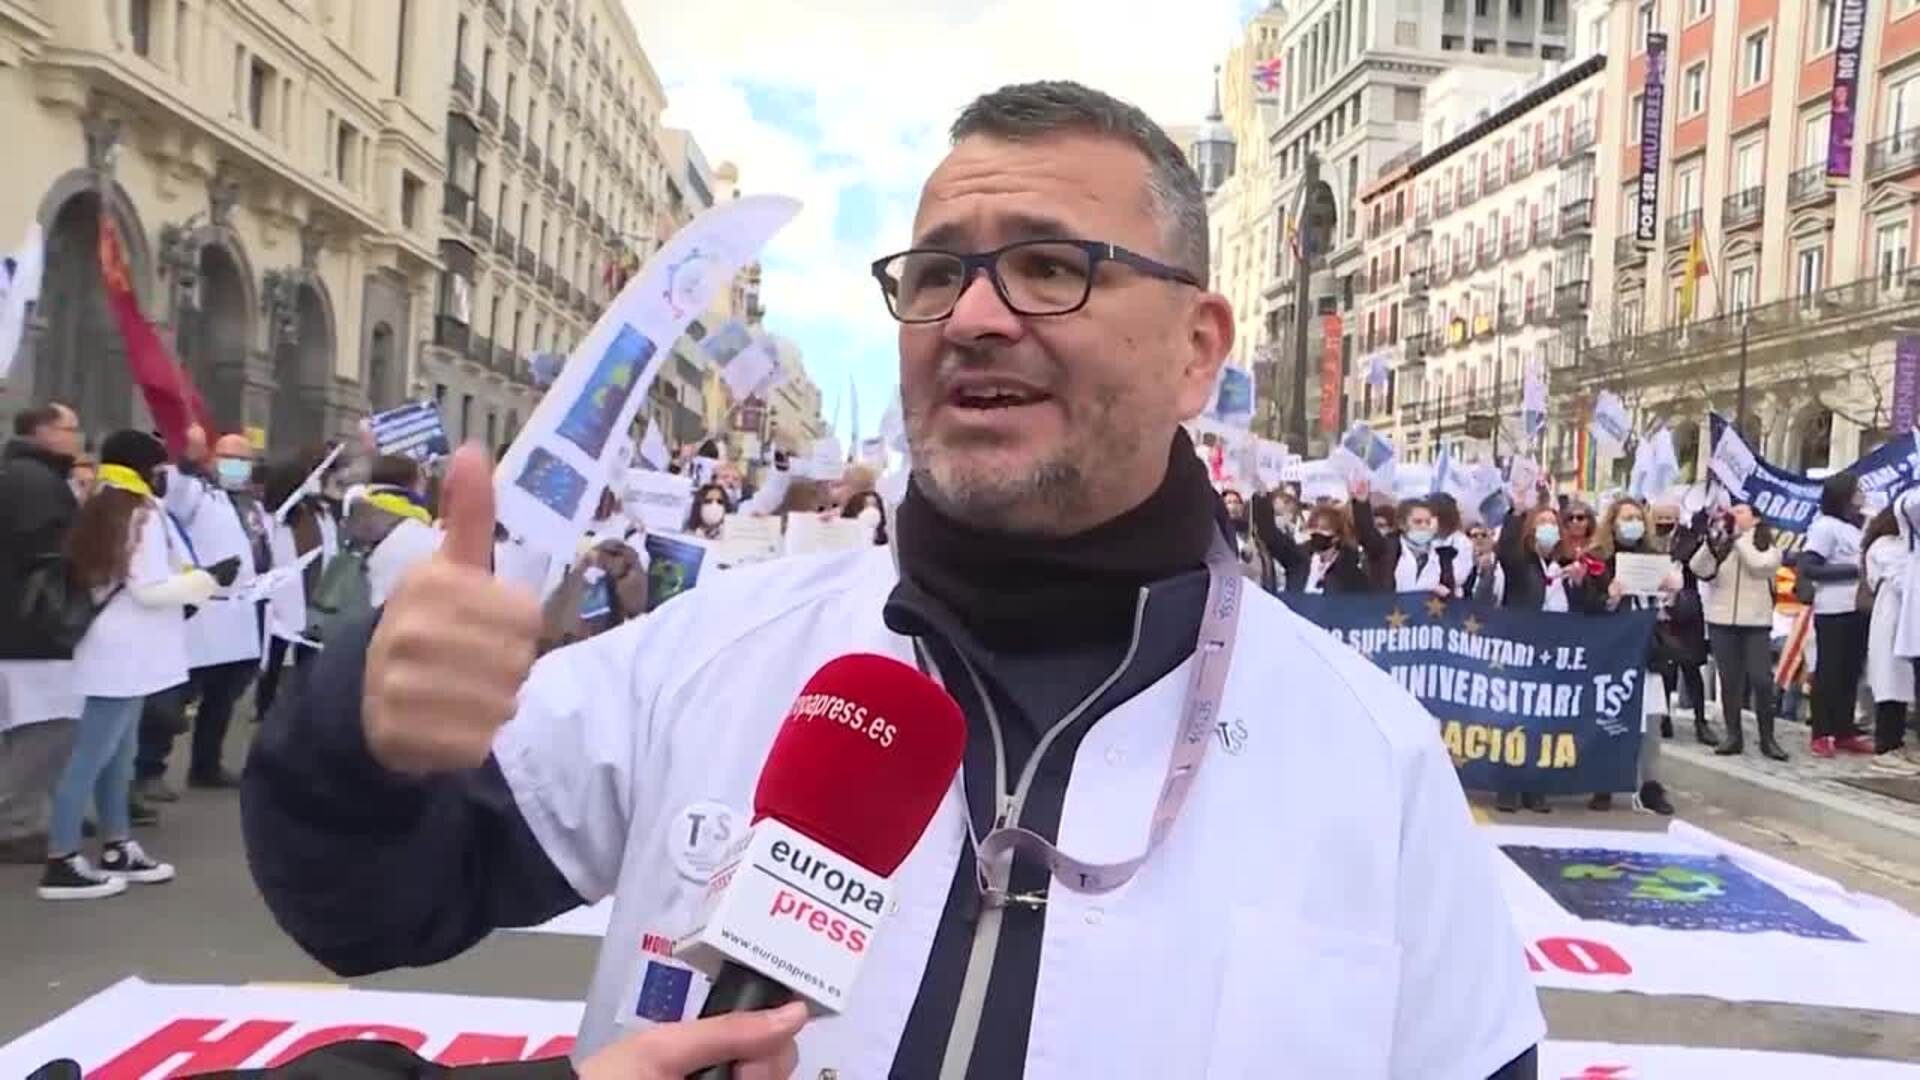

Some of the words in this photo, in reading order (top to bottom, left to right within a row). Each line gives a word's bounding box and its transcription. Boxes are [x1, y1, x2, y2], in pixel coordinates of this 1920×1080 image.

[1644, 87, 1662, 169] MUJERES
[1643, 172, 1656, 201] SER
[1640, 203, 1654, 238] POR
[1349, 624, 1444, 653] SUPERIOR
[1448, 628, 1535, 667] SANITARI
[1536, 732, 1578, 769] JA
[770, 840, 885, 915] europa
[769, 890, 867, 953] press
[721, 929, 841, 998] www.europapress.es
